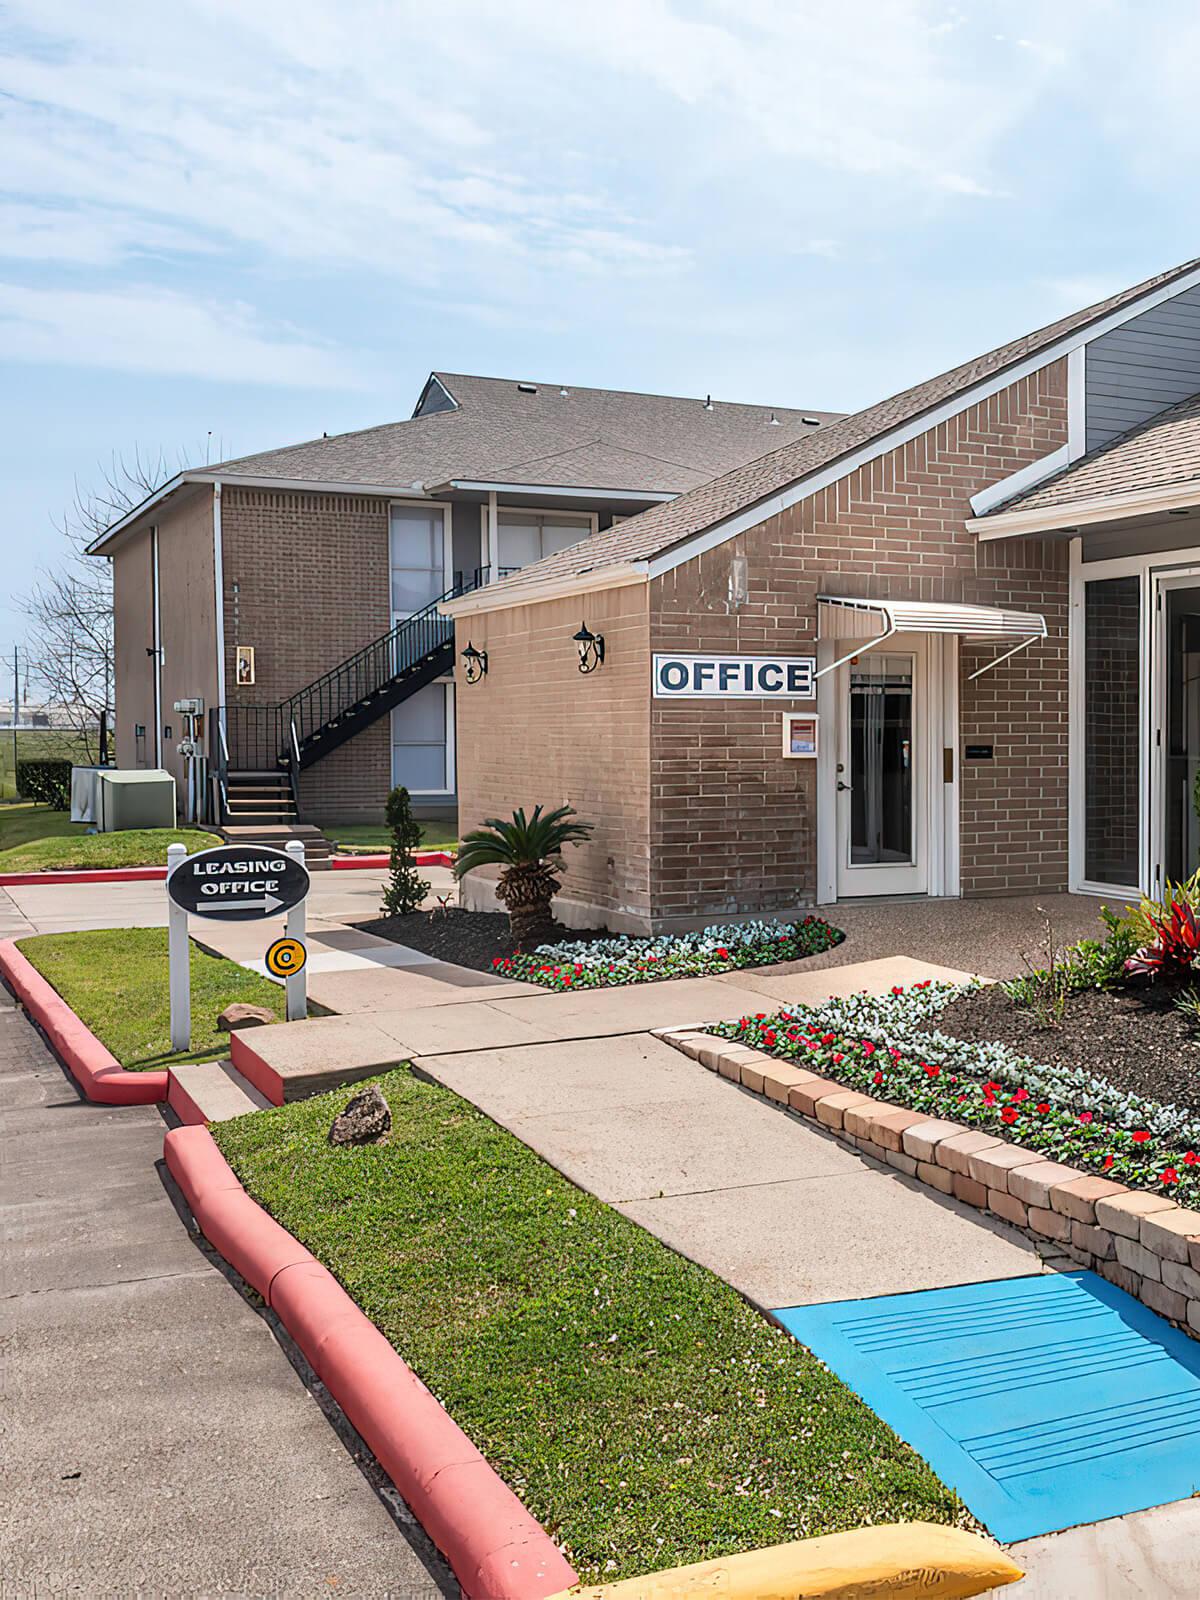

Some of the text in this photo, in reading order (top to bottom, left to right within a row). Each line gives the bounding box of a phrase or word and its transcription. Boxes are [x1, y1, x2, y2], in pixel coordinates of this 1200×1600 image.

[660, 661, 810, 692] OFFICE
[193, 860, 286, 876] LEASING
[200, 880, 279, 895] OFFICE
